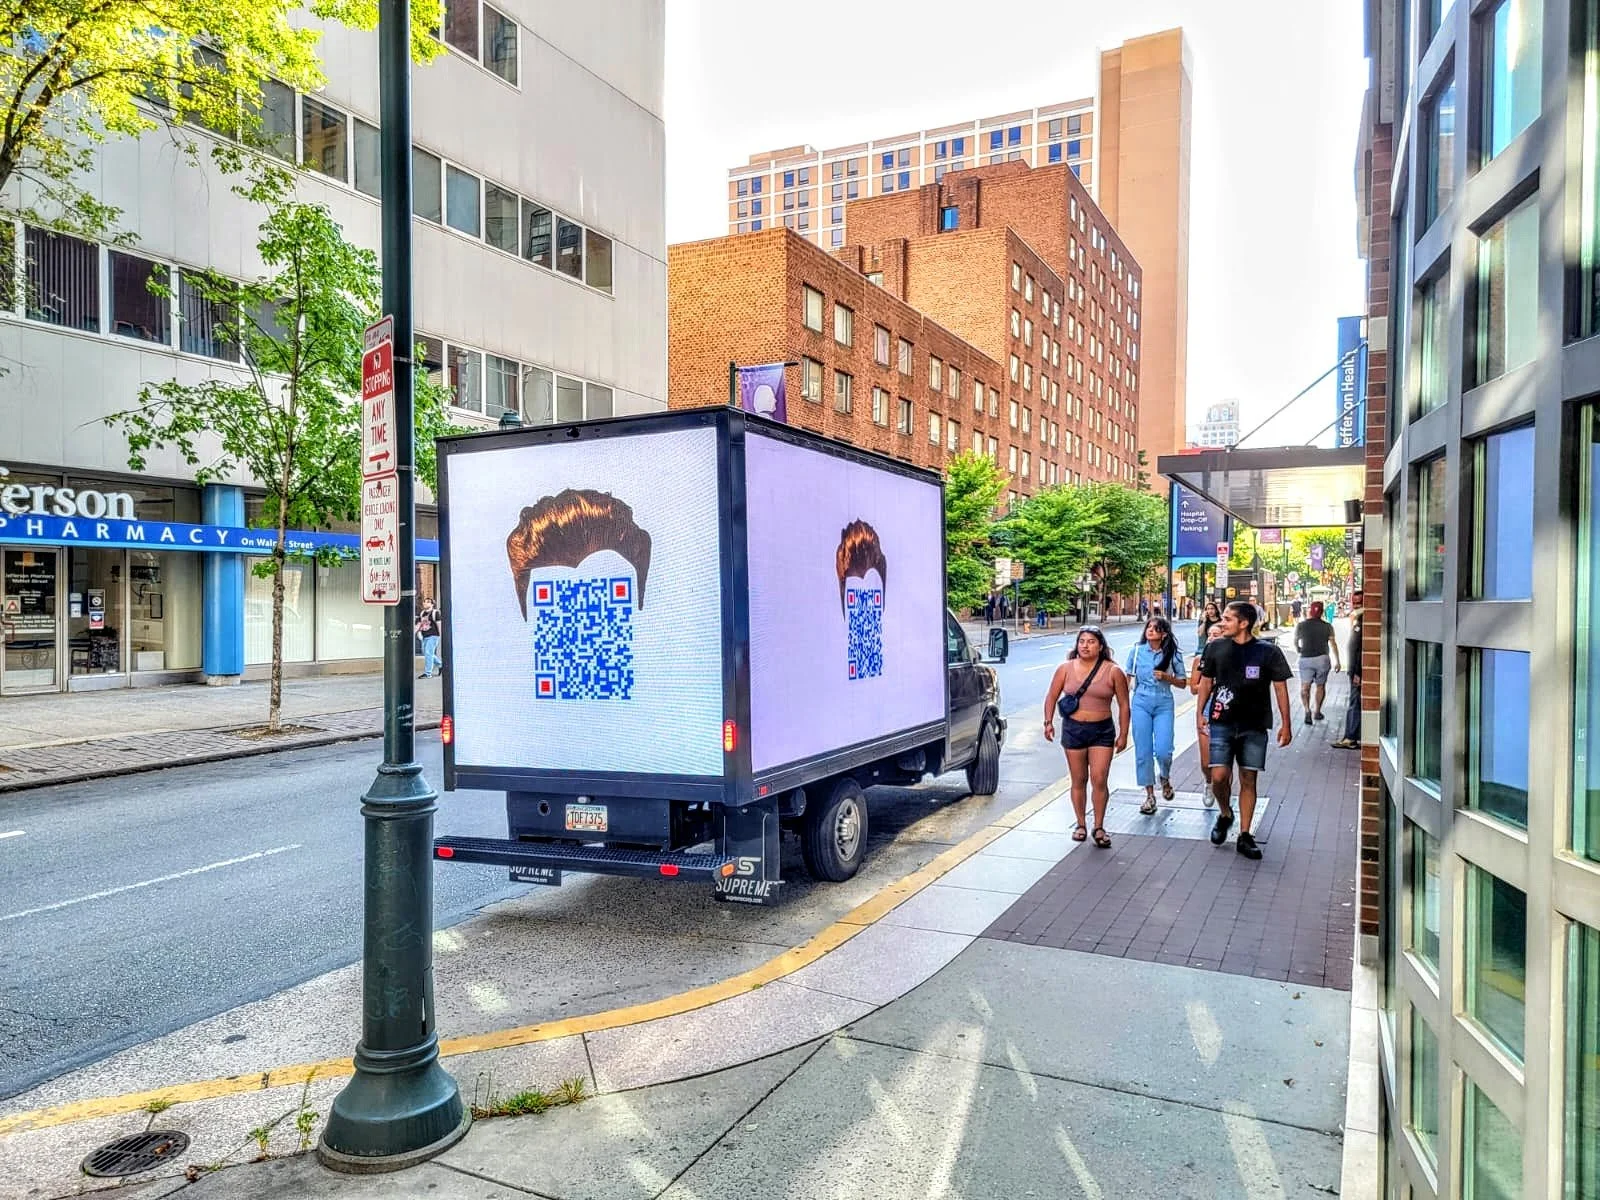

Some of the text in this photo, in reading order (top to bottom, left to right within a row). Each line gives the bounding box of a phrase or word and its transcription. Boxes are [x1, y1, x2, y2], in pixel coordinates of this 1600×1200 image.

[365, 369, 391, 394] STOPPING
[372, 398, 386, 423] ANY
[371, 423, 388, 446] TIME
[241, 537, 254, 546] On
[288, 540, 315, 549] Street
[715, 878, 772, 898] SUPREME
